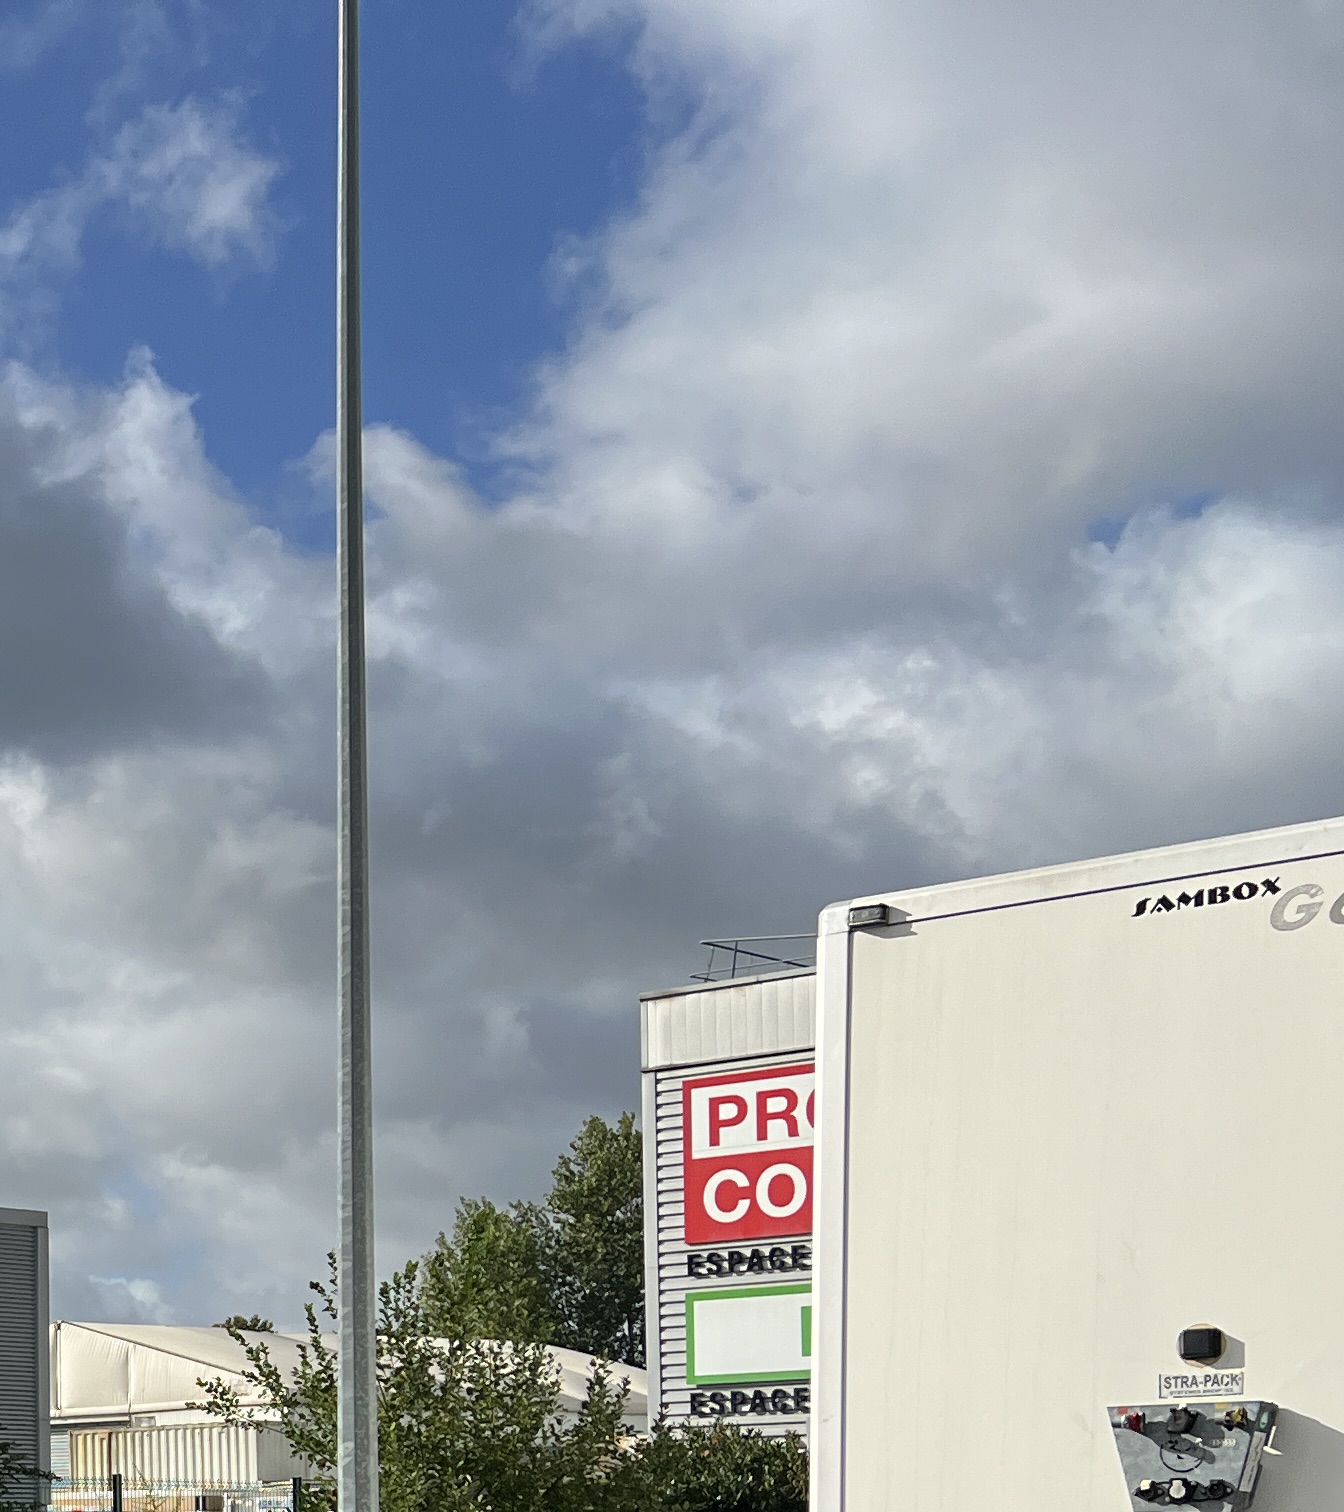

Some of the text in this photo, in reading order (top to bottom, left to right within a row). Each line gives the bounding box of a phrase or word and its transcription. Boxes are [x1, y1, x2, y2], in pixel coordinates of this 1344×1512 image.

[1131, 876, 1344, 931] SAMBOX G
[708, 1088, 815, 1147] PR
[687, 1245, 812, 1277] ESPACE
[690, 1387, 810, 1418] ESPACE
